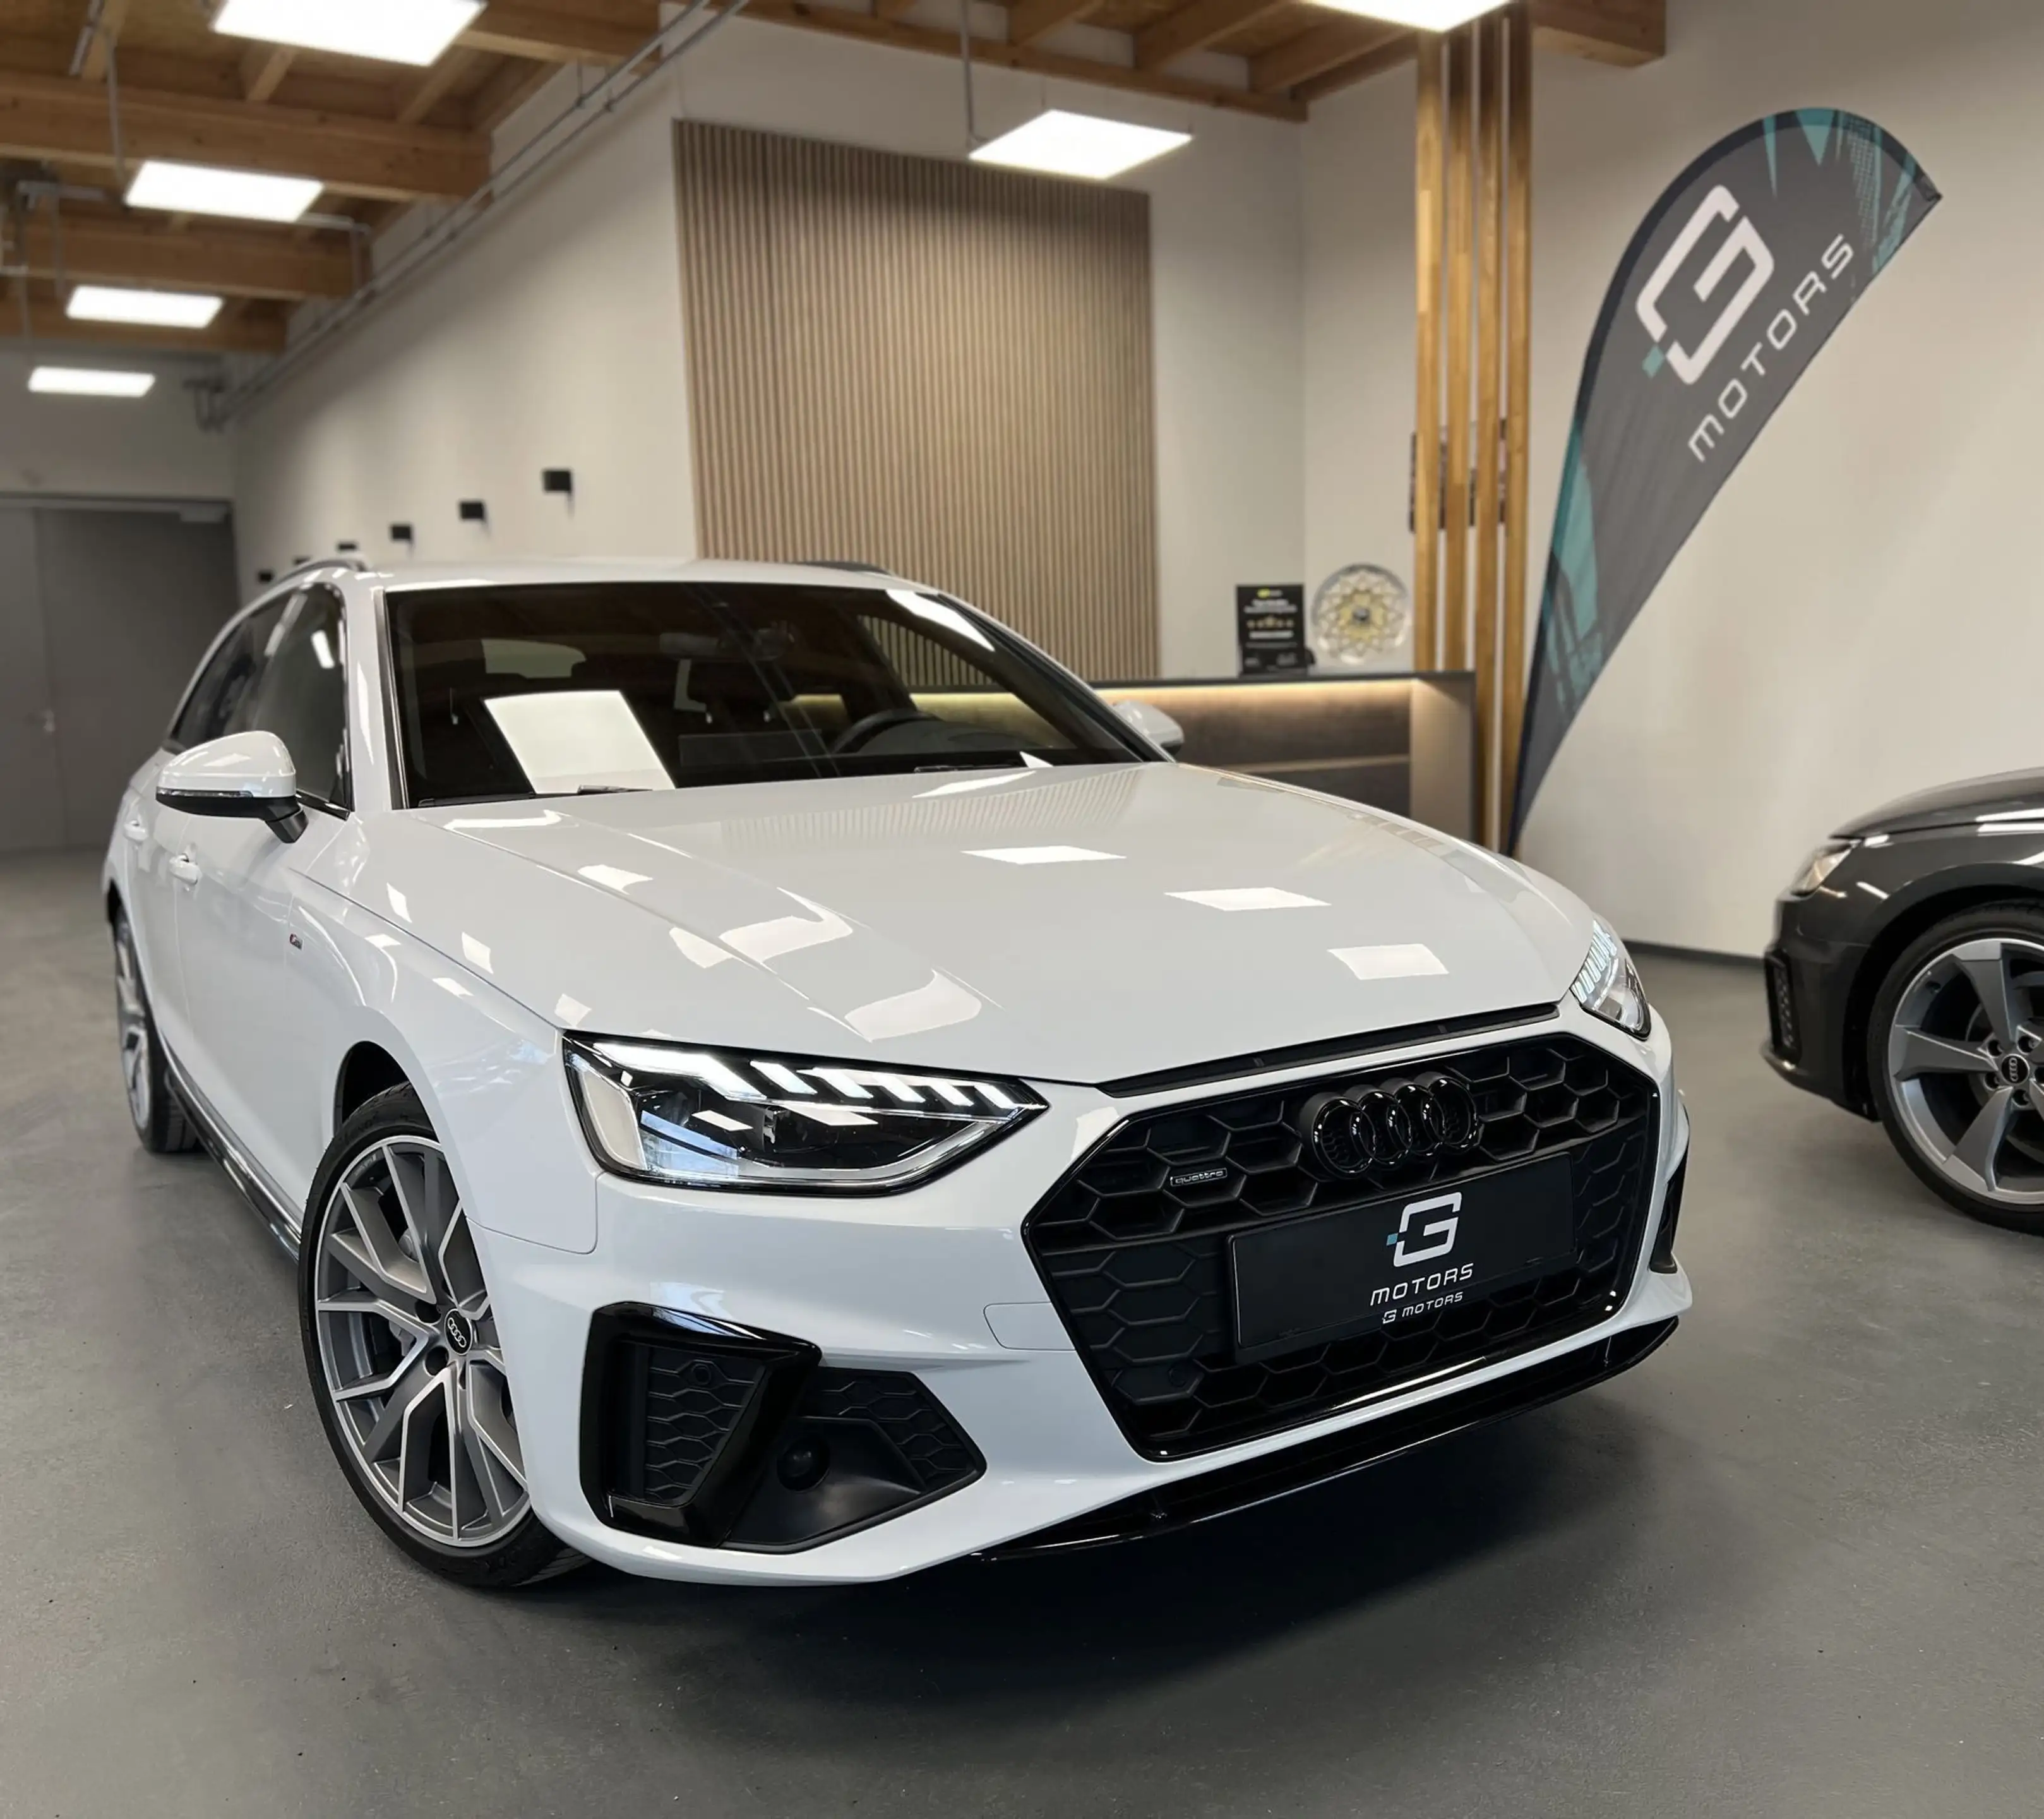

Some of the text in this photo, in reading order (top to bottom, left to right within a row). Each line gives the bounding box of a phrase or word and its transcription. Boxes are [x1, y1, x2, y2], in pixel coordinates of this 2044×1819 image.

[1687, 234, 1854, 463] MOTORS
[1175, 1170, 1224, 1184] quattro
[1370, 1263, 1474, 1306] MOTORS
[1401, 1291, 1464, 1318] MOTORS
